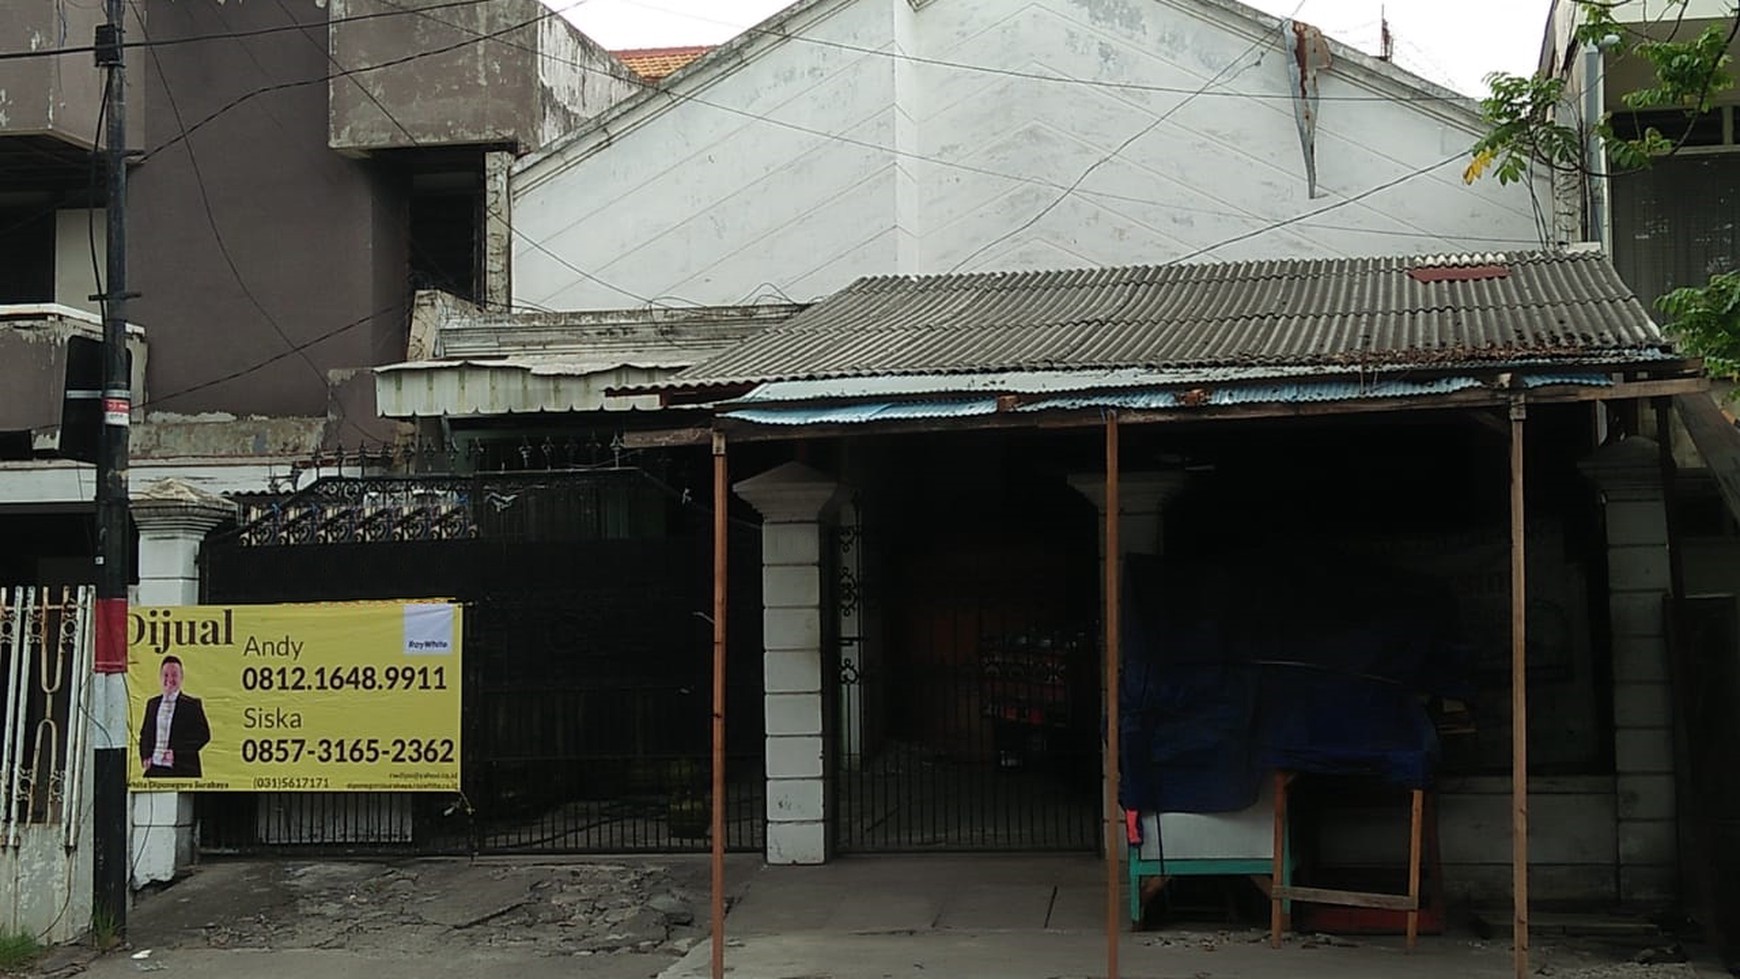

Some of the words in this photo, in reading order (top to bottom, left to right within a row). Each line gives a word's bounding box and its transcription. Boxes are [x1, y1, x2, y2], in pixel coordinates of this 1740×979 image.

[128, 608, 234, 654] Dijual
[243, 635, 303, 660] Andy
[242, 666, 447, 691] 0812.1648.9911
[243, 707, 302, 729] Siska
[242, 738, 455, 763] 0857-3165-2362
[253, 777, 329, 789] (031)5617171
